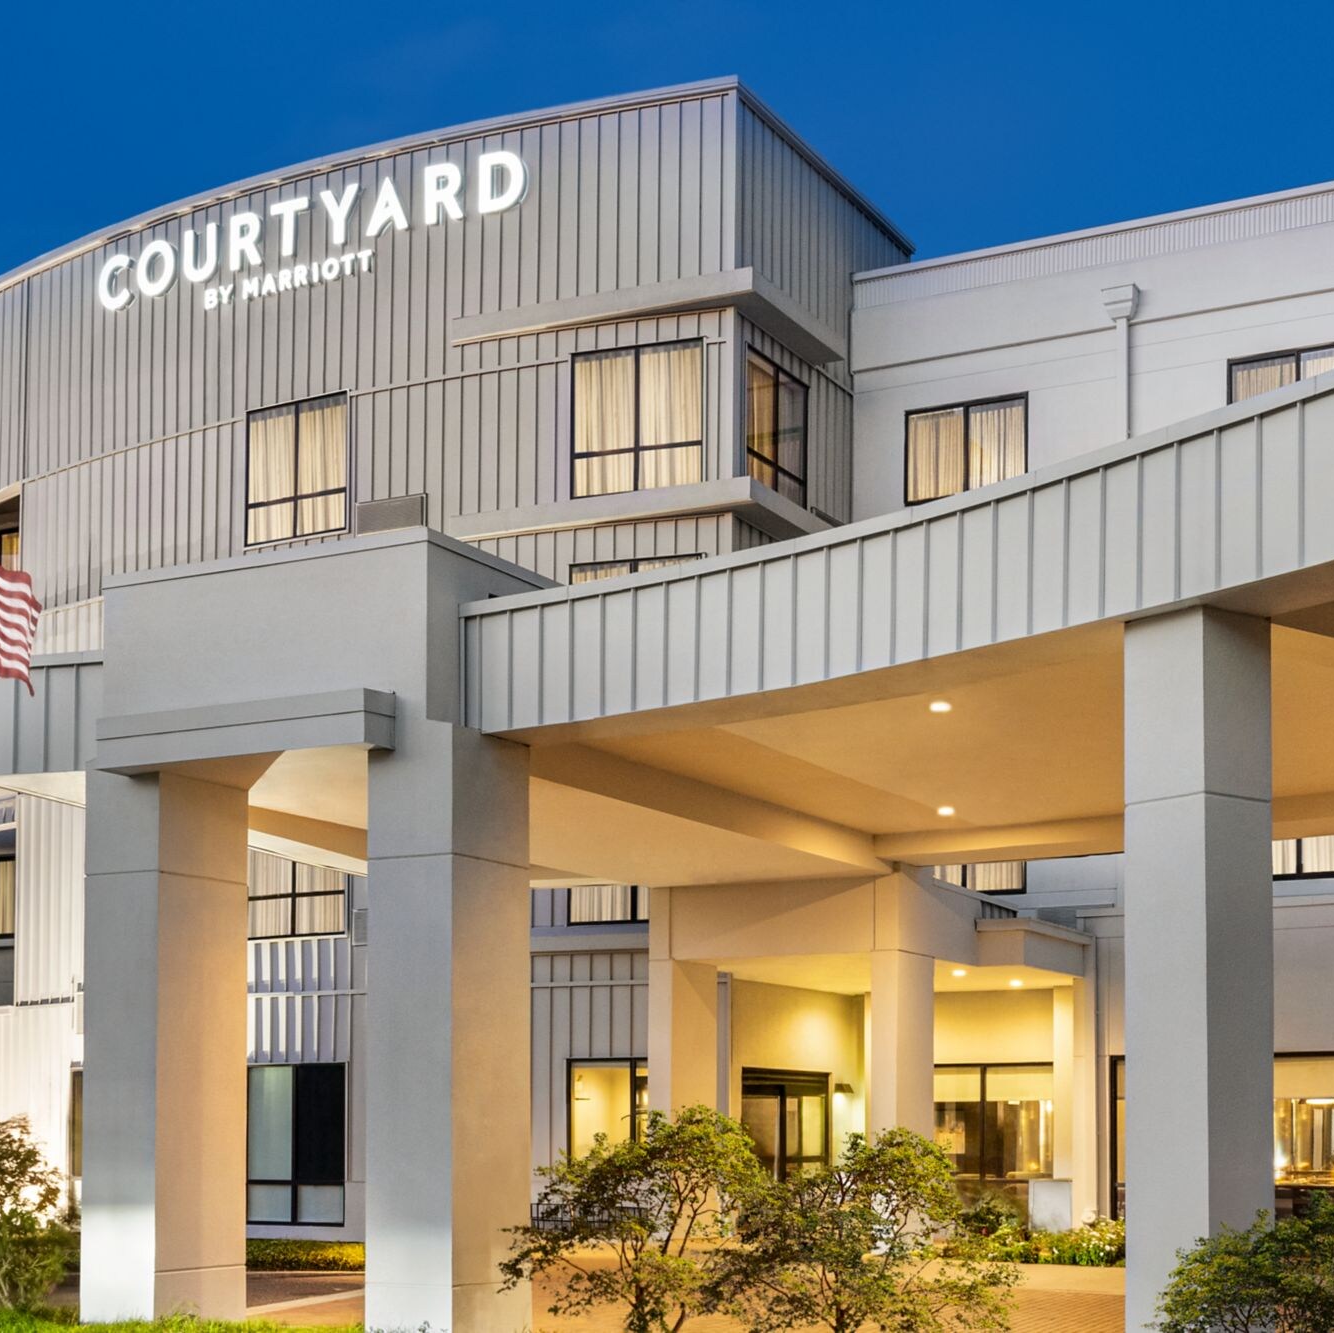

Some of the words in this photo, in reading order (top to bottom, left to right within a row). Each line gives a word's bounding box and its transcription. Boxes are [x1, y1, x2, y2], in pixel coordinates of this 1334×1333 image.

[98, 150, 527, 311] COURTYARD
[203, 284, 234, 311] BY
[242, 249, 374, 301] MARRIOTT
